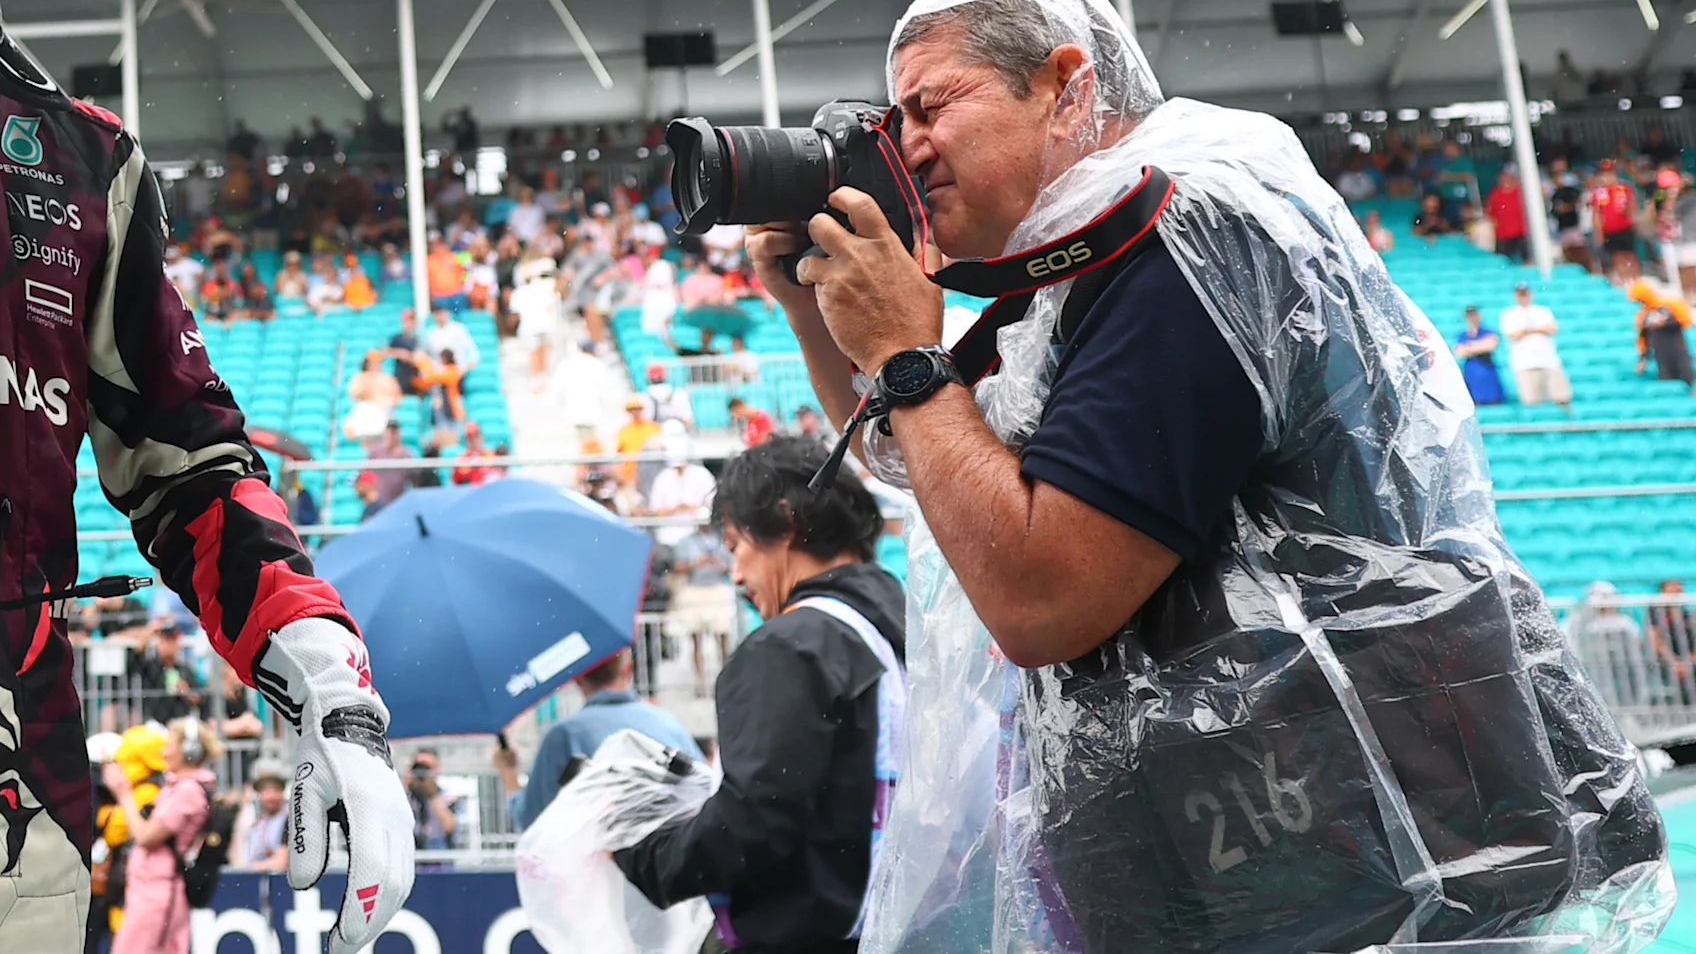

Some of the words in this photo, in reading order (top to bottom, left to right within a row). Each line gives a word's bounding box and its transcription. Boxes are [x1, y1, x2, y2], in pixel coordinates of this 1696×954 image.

[5, 191, 82, 231] NEOS
[1026, 240, 1093, 278] EOS
[294, 782, 307, 855] WhatsApp
[1184, 751, 1313, 874] 216
